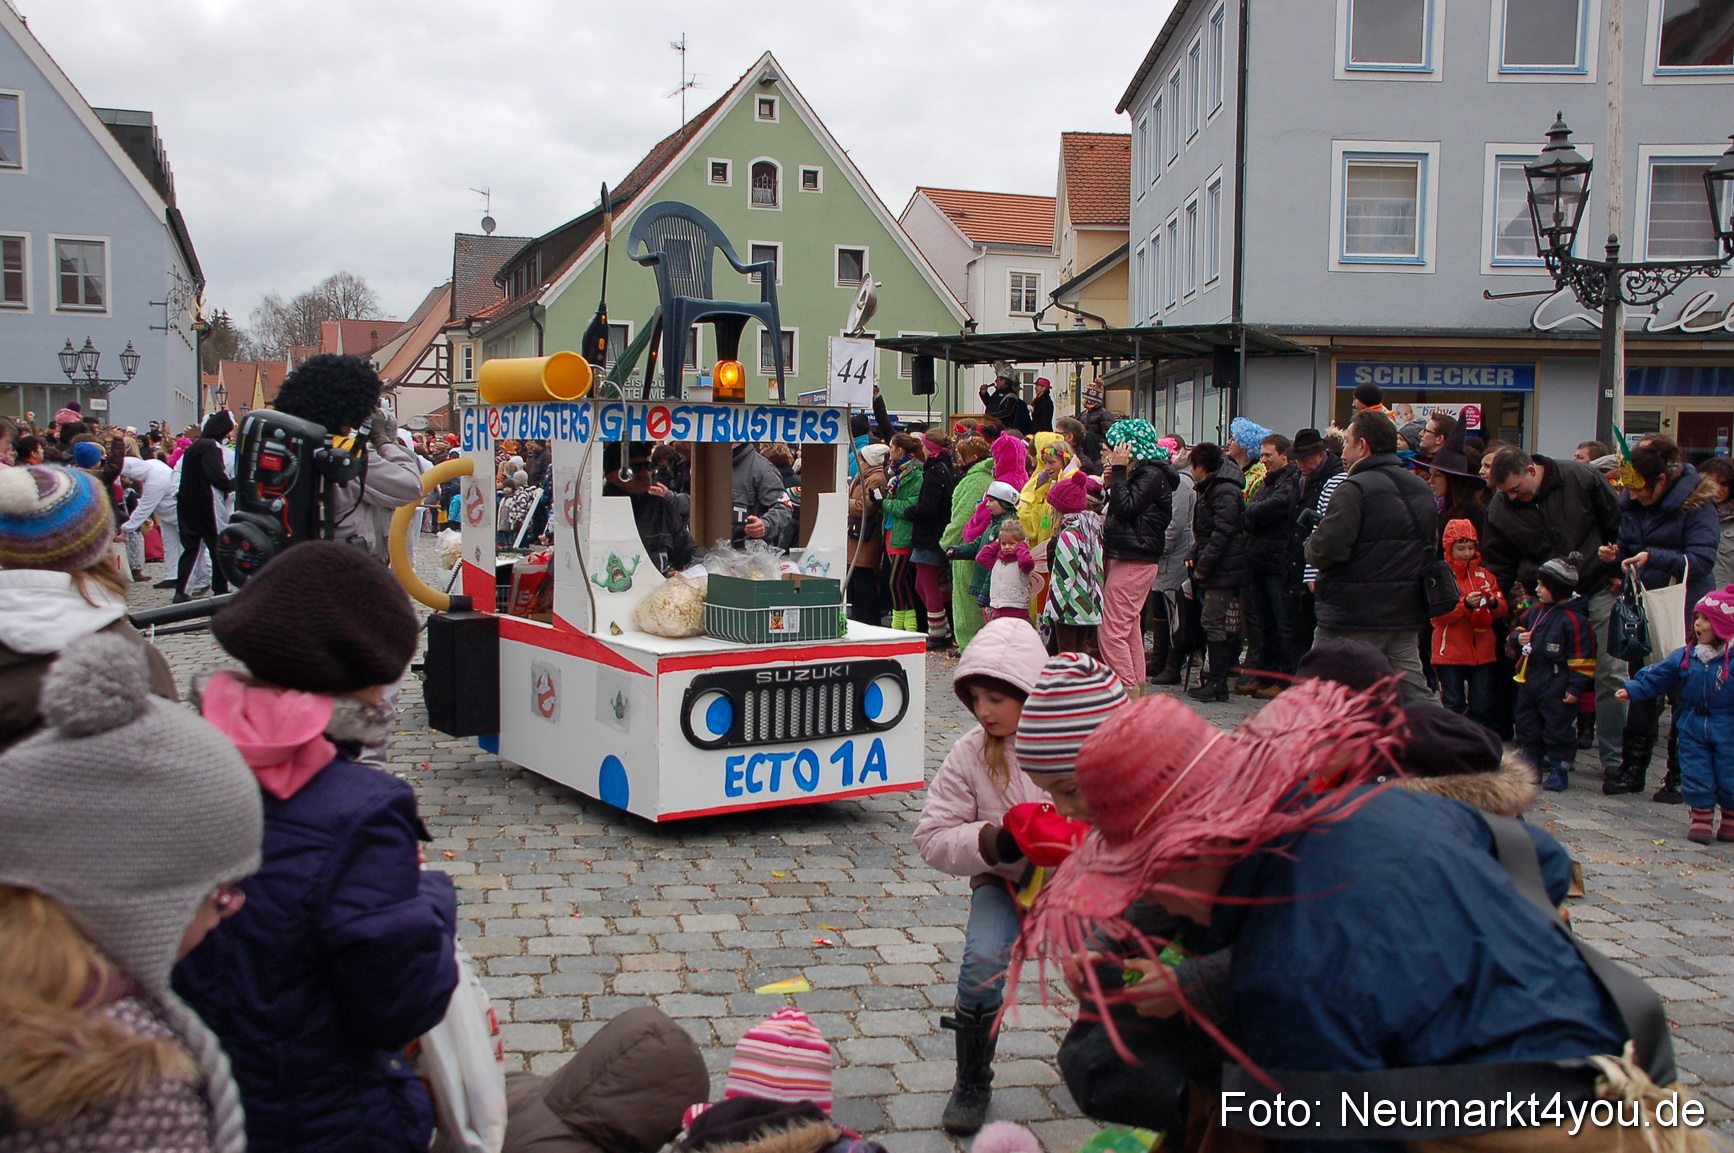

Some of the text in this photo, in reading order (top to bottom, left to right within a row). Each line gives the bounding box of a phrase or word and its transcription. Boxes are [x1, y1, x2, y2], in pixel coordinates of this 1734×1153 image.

[837, 357, 869, 384] 44
[1354, 366, 1514, 386] SCHLECKER
[756, 665, 850, 684] SUZUKI
[725, 748, 820, 798] ECTO
